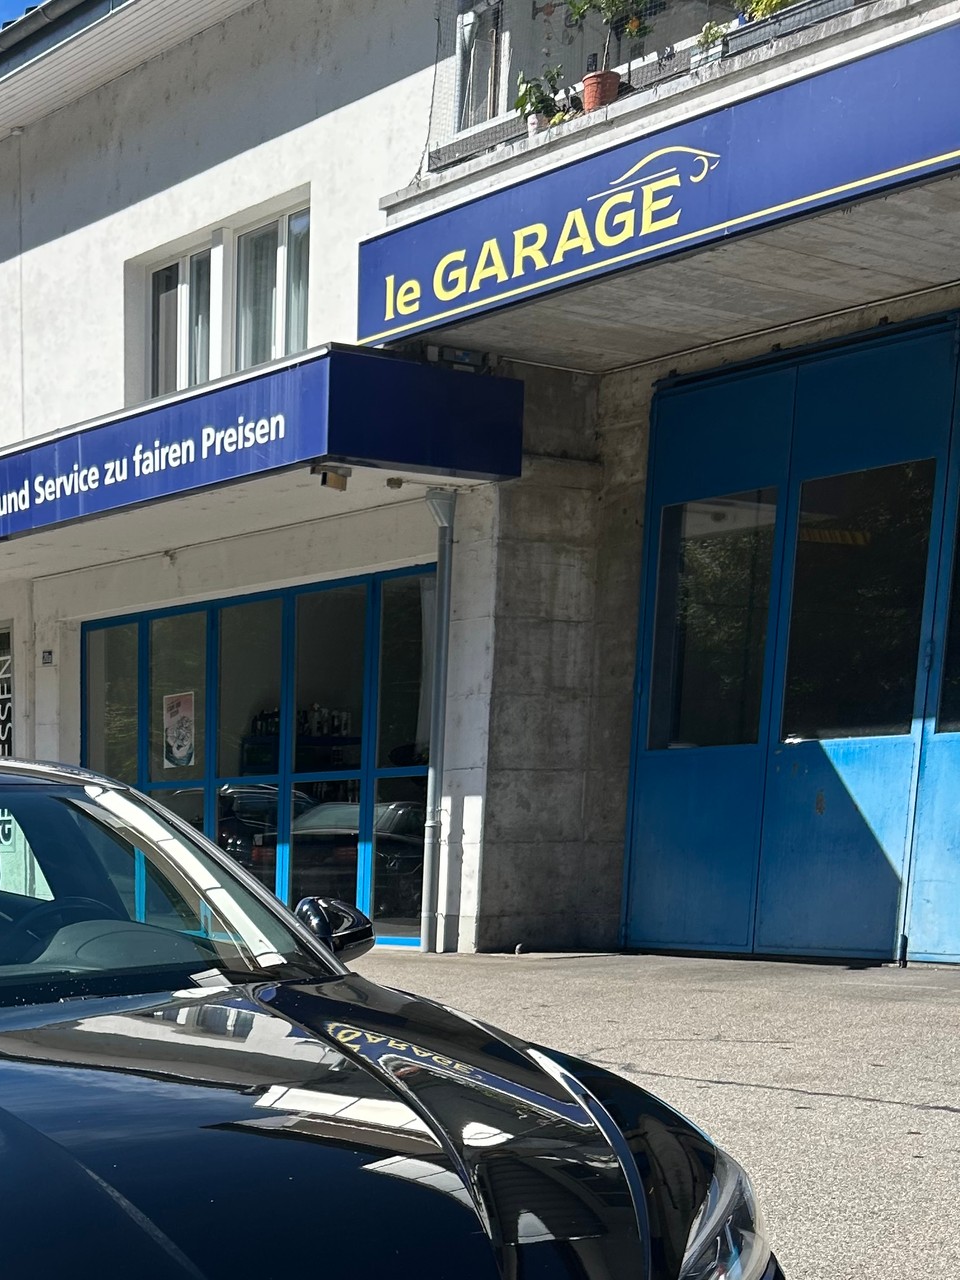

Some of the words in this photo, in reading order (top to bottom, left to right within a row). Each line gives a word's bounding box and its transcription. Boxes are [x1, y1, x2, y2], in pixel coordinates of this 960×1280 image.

[384, 274, 421, 321] le
[433, 174, 681, 302] GARAGE
[35, 465, 99, 505] Service
[104, 455, 128, 485] zu
[133, 439, 195, 477] fairen
[201, 413, 285, 460] Preisen
